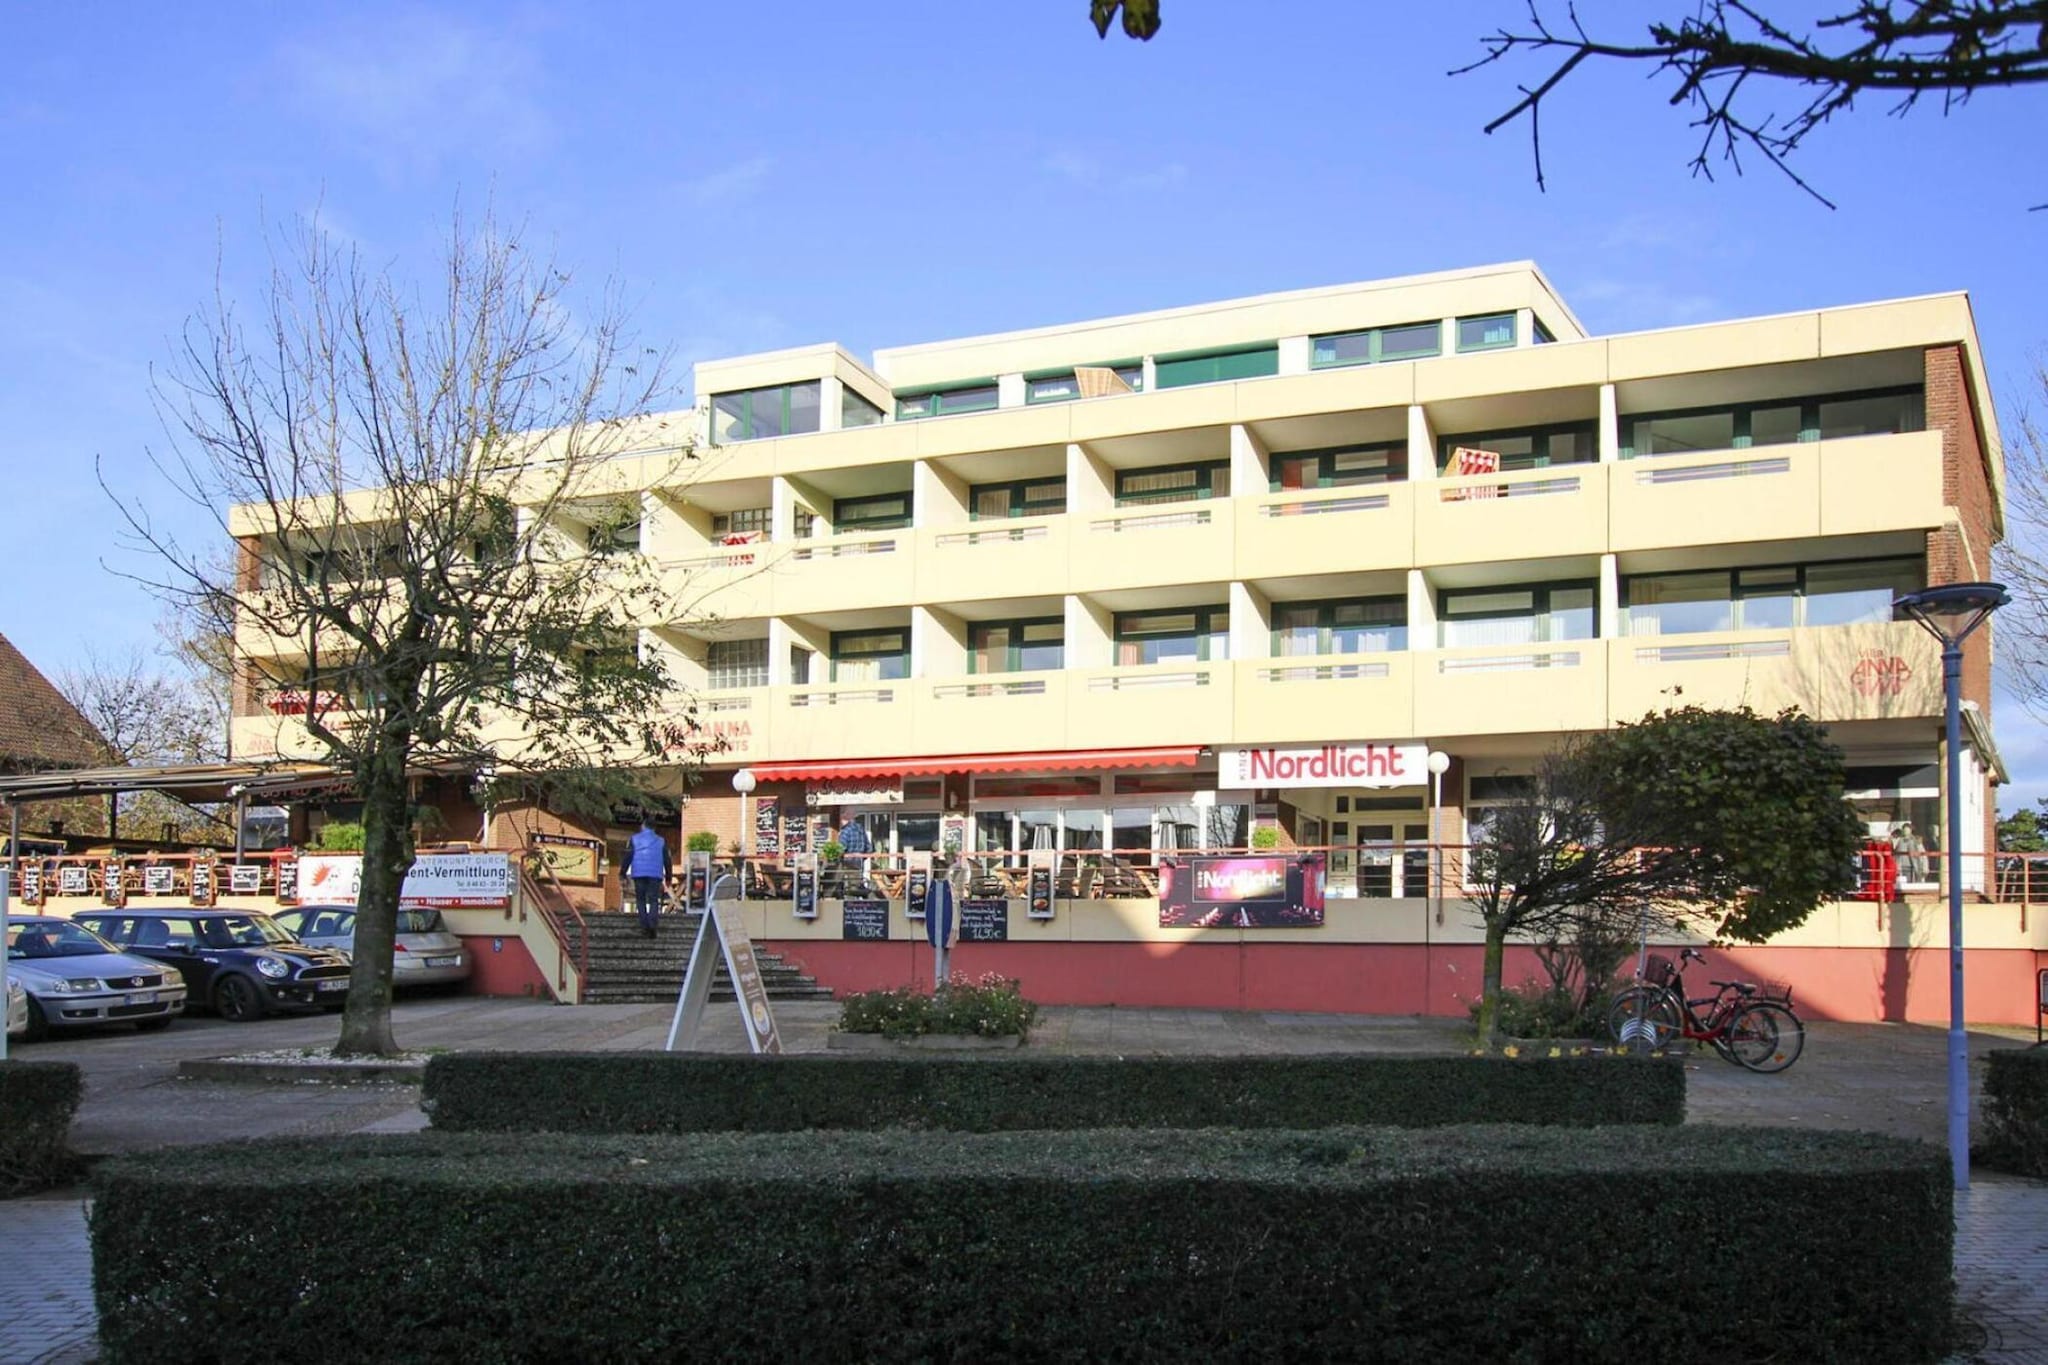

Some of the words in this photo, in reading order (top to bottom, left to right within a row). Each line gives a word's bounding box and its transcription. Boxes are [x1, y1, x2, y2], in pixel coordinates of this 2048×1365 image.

[701, 720, 753, 737] ANNA
[1251, 744, 1405, 779] Nordlicht
[476, 855, 506, 864] DURCH
[405, 865, 506, 880] ent-Vermittlung
[1204, 869, 1282, 889] Nordlicht
